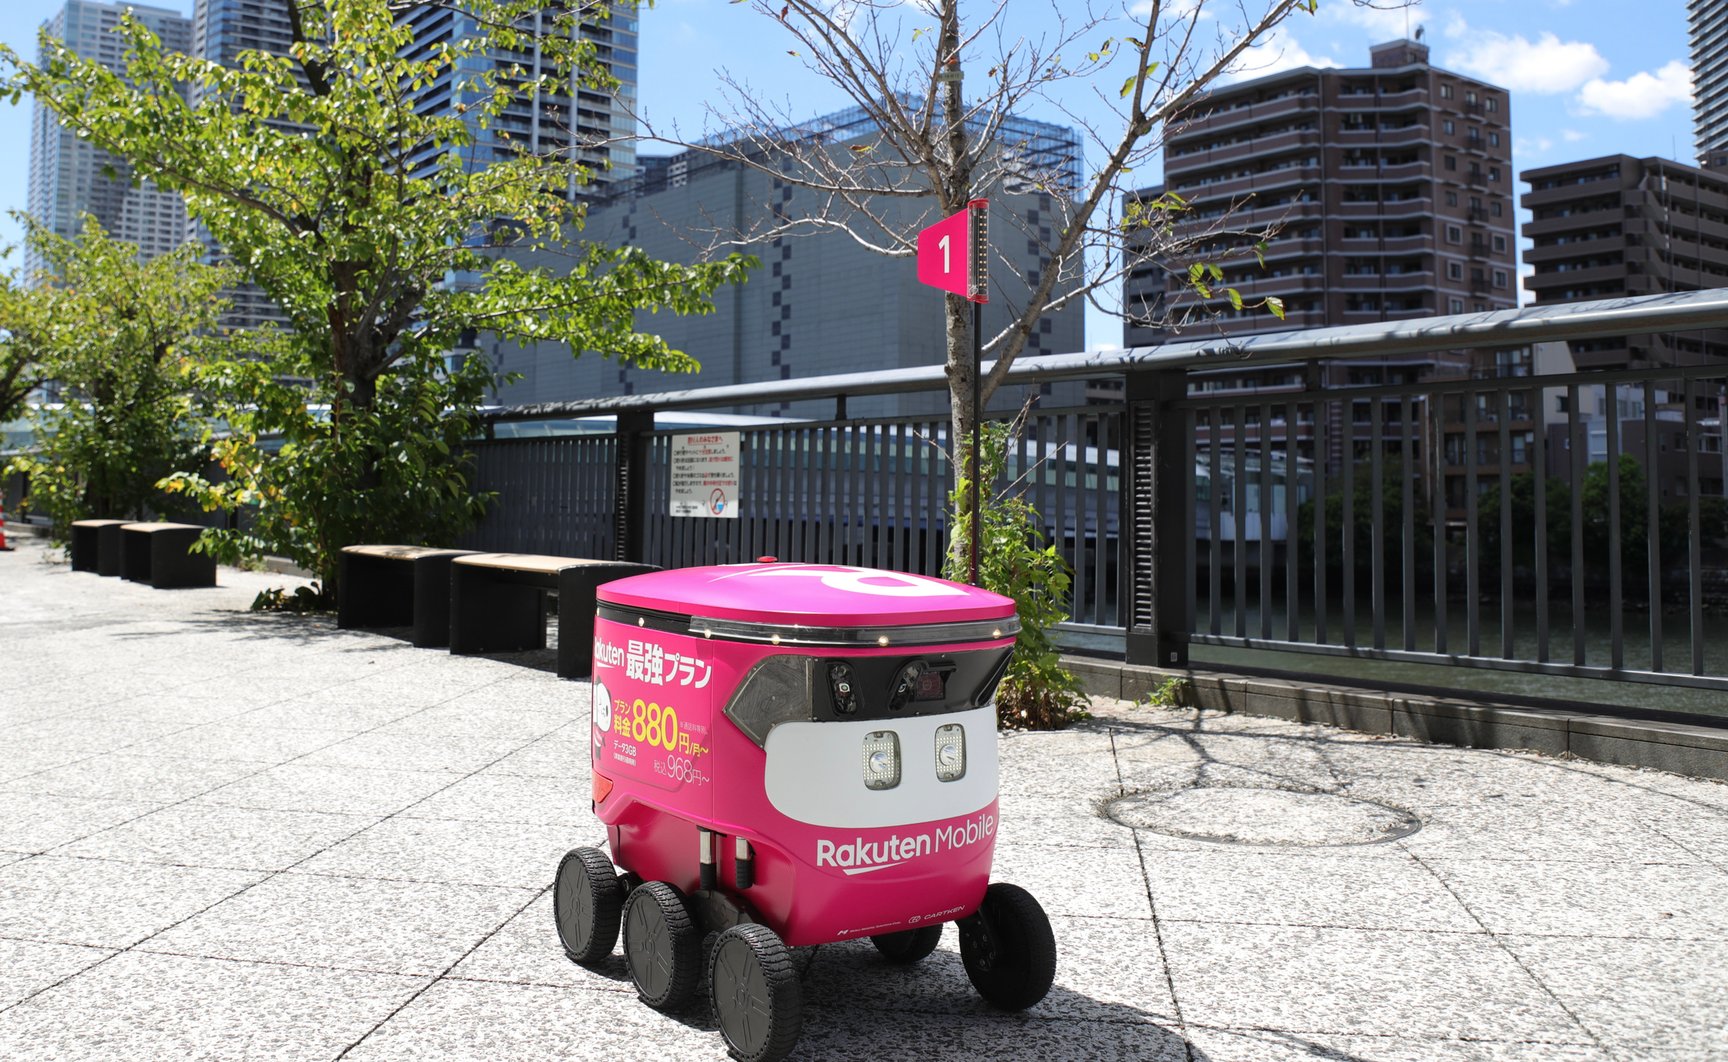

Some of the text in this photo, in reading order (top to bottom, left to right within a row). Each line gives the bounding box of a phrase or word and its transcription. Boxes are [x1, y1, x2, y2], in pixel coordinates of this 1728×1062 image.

[938, 234, 950, 274] 1
[594, 636, 712, 689] akuten 最強プラン
[816, 813, 994, 867] Rakuten Mobile
[924, 905, 966, 920] CARTKEN
